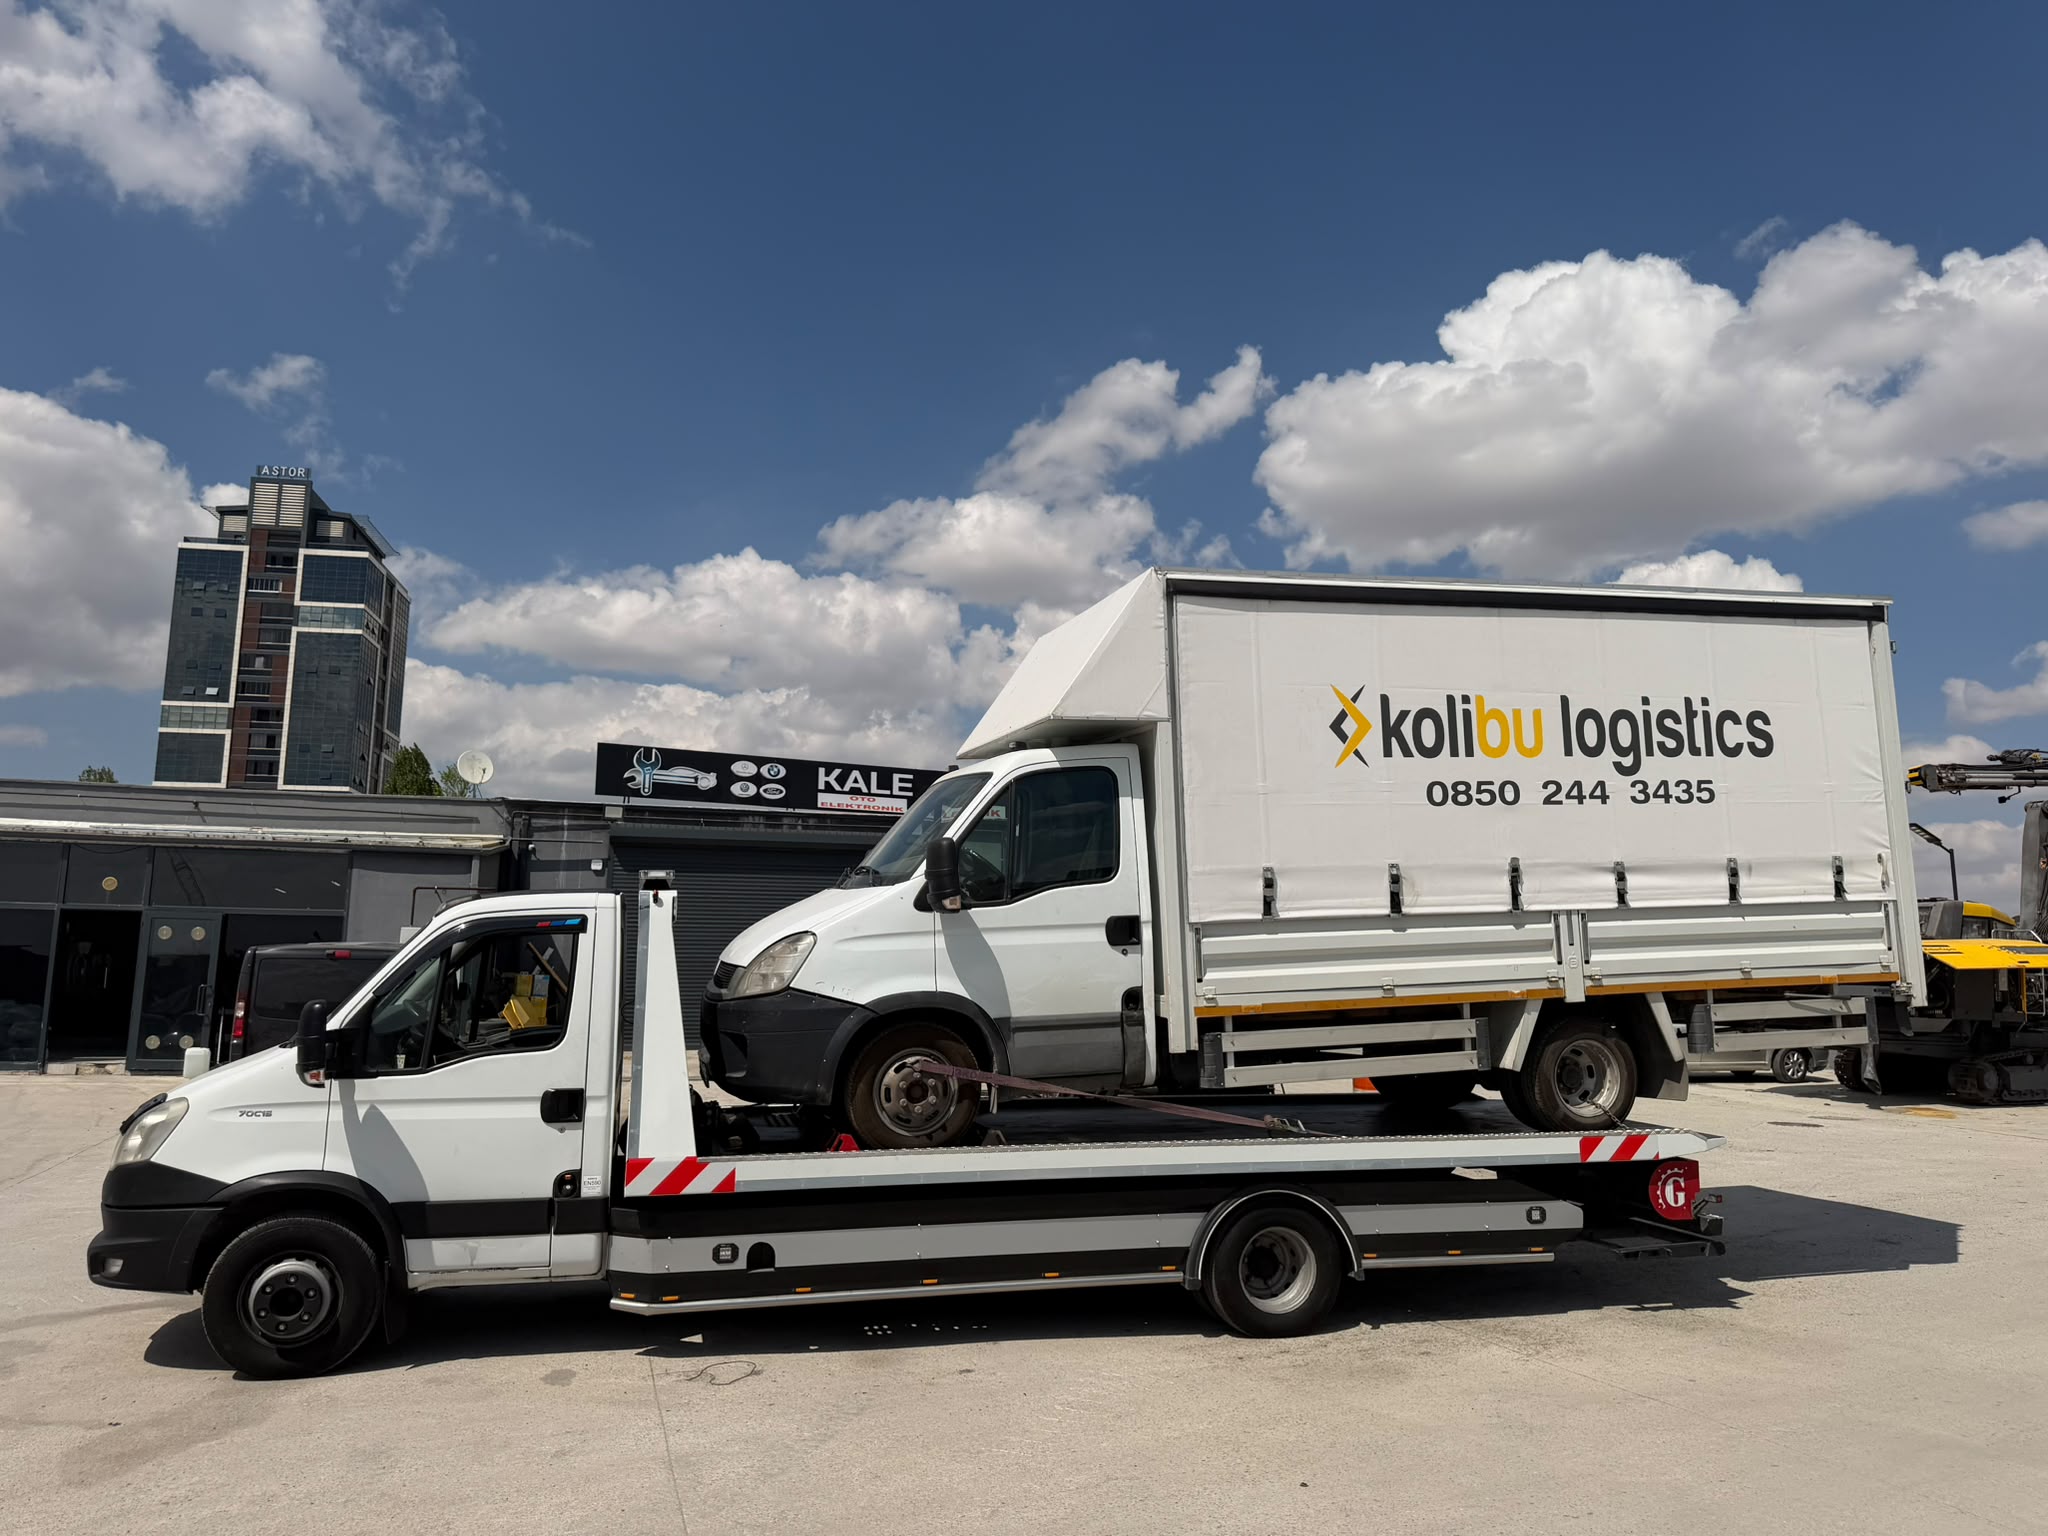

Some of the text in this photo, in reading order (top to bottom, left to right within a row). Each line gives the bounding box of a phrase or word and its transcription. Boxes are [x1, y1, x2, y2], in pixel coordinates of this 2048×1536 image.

[261, 465, 305, 477] ASTOR
[1380, 693, 1774, 777] kolibu logistics
[818, 767, 913, 796] KALE
[1426, 779, 1716, 807] 0850 244 3435
[820, 802, 904, 812] ELEKTRONİK
[1665, 1176, 1686, 1207] G
